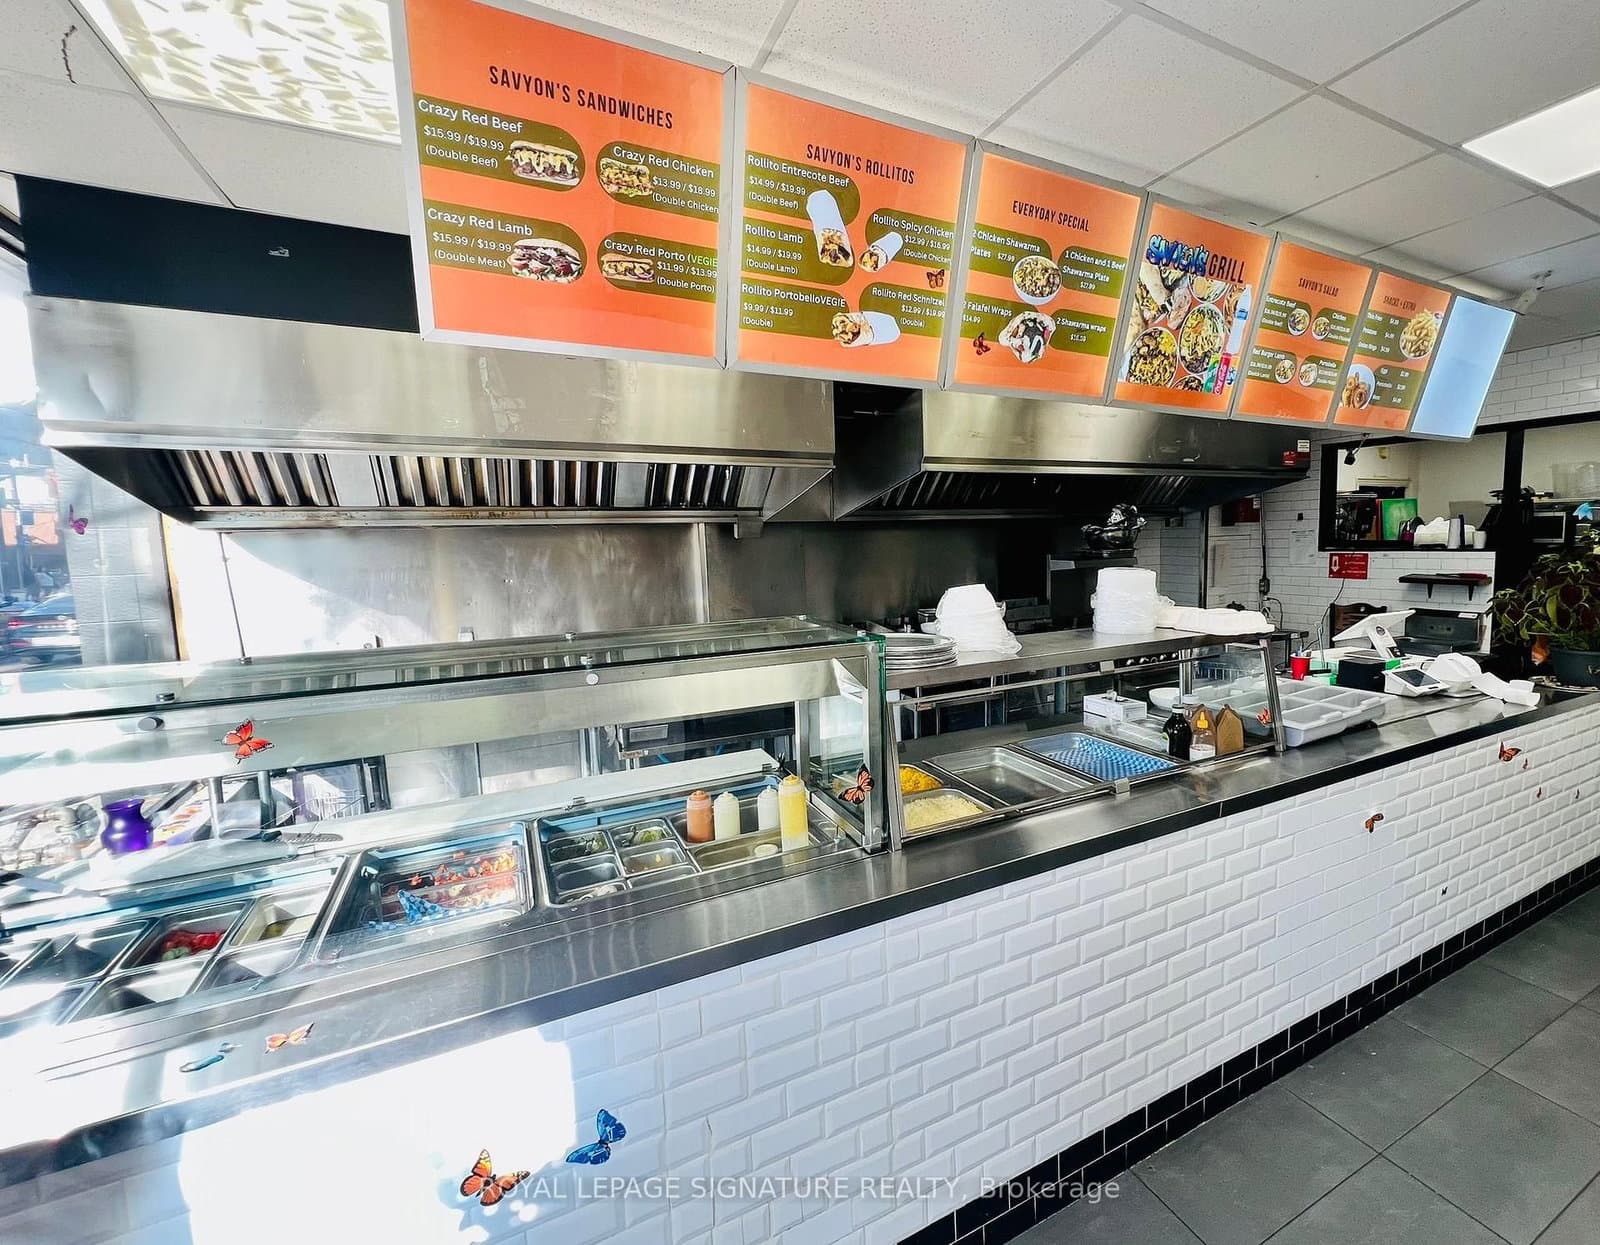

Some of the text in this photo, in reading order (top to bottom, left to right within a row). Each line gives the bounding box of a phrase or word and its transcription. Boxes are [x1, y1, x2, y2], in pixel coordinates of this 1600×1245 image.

[489, 66, 673, 129] SAVYON'S SANDWICHES
[418, 99, 523, 133] Crazy Red Beef
[423, 125, 461, 142] $15.99
[425, 144, 498, 169] (Double Beef)
[613, 145, 714, 179] Crazy Red Chicken
[807, 144, 915, 184] SAVYON'S ROLLITOS
[747, 155, 850, 187] Rollito Entrecote Beef
[652, 176, 681, 190] $13.99
[652, 192, 685, 207] (Double
[748, 192, 799, 210] (Double Beef)
[427, 208, 533, 236] Crazy Red Lamb
[873, 213, 954, 239] Rollito Spicy Chicken
[1013, 200, 1089, 232] EVERYDAY SPECIAL
[433, 231, 468, 246] $15.99
[477, 238, 512, 253] $19.99
[745, 224, 804, 244] Rollito Lamb
[977, 231, 1005, 244] Chicken
[1006, 237, 1040, 252] Shawarma
[434, 249, 506, 269] (Double Meat)
[604, 239, 633, 254] Crazy
[636, 244, 655, 257] Red
[658, 248, 685, 262] Porto
[656, 260, 684, 273] $11.99
[746, 258, 798, 275] (Double Lamb)
[1208, 253, 1245, 284] GRILL
[656, 276, 715, 293] (Double Porto)
[742, 283, 772, 297] Rollito
[872, 287, 896, 299] Rollito
[898, 291, 912, 301] Red
[743, 316, 773, 328] (Double)
